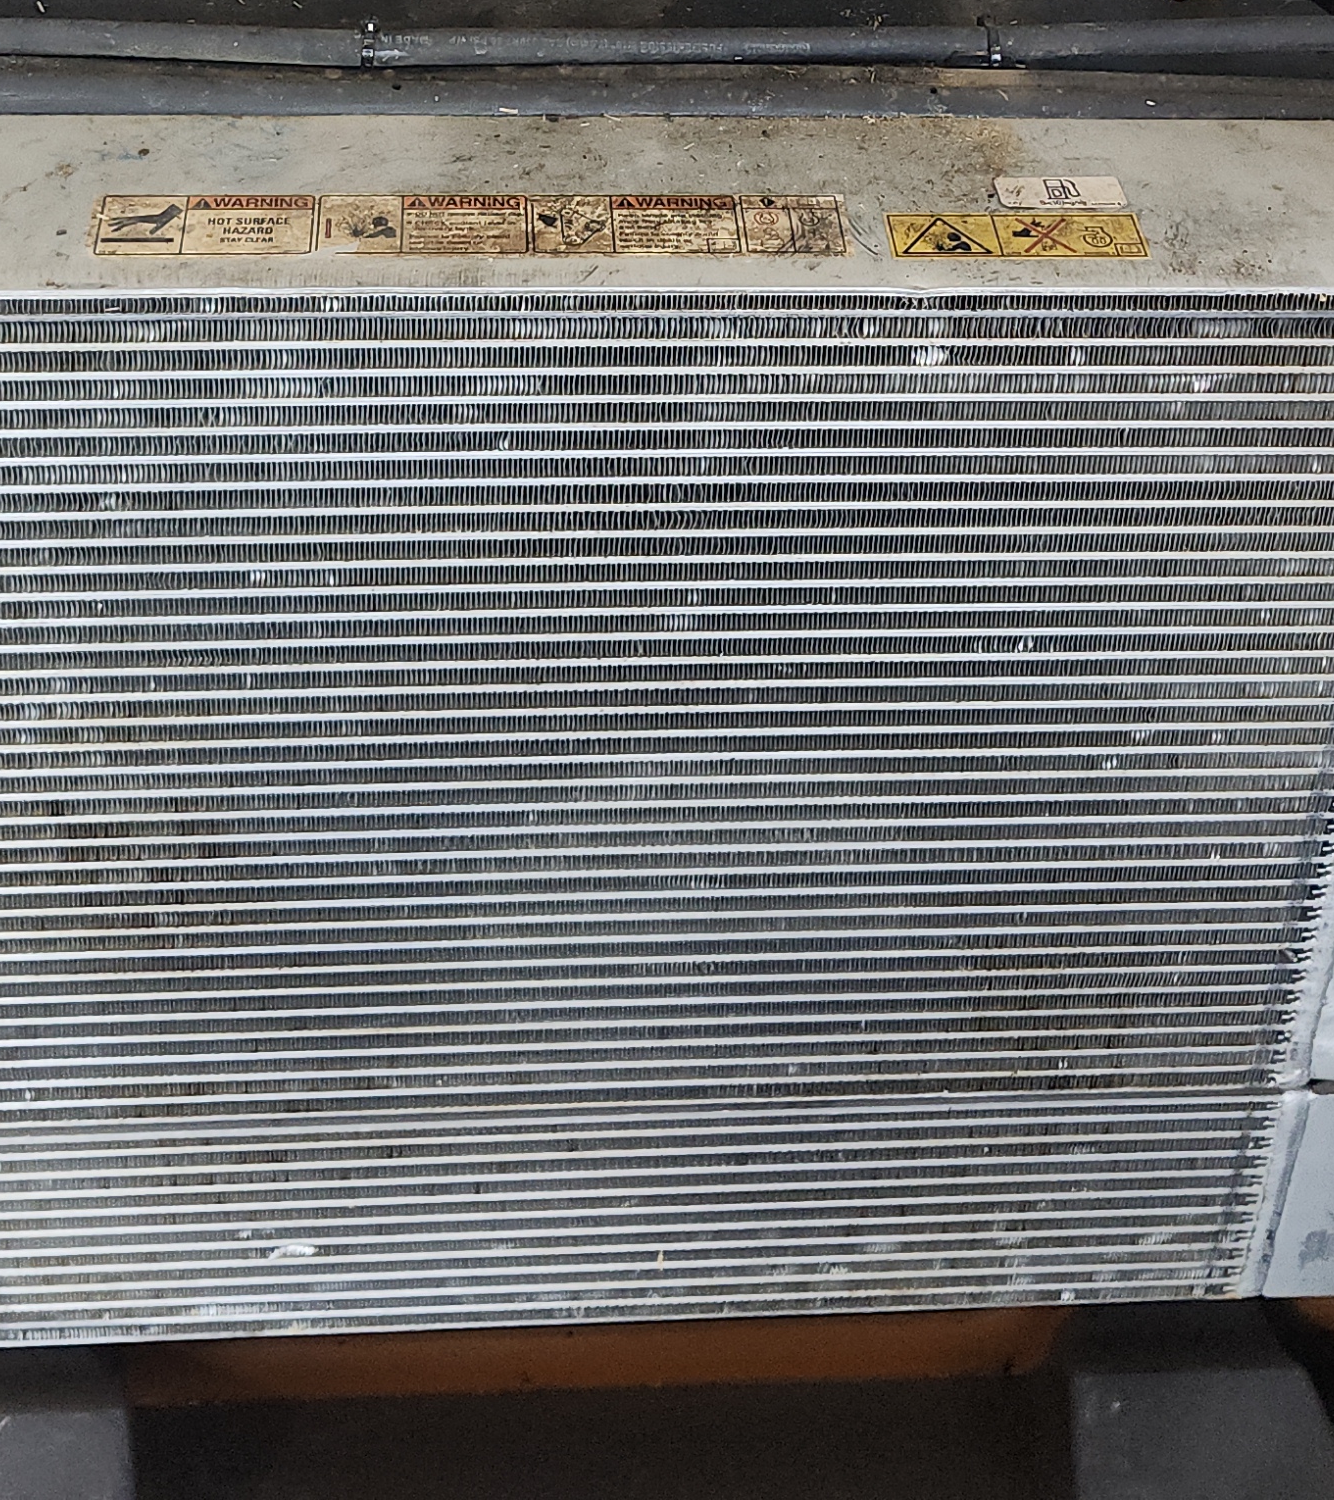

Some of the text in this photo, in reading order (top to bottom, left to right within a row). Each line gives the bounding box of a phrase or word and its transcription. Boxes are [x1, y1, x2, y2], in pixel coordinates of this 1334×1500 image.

[214, 197, 309, 208] WARNING
[429, 197, 520, 208] WARNING
[635, 197, 727, 207] WARNING
[208, 217, 290, 226] HOT SURFACE
[223, 226, 273, 235] HAZARD
